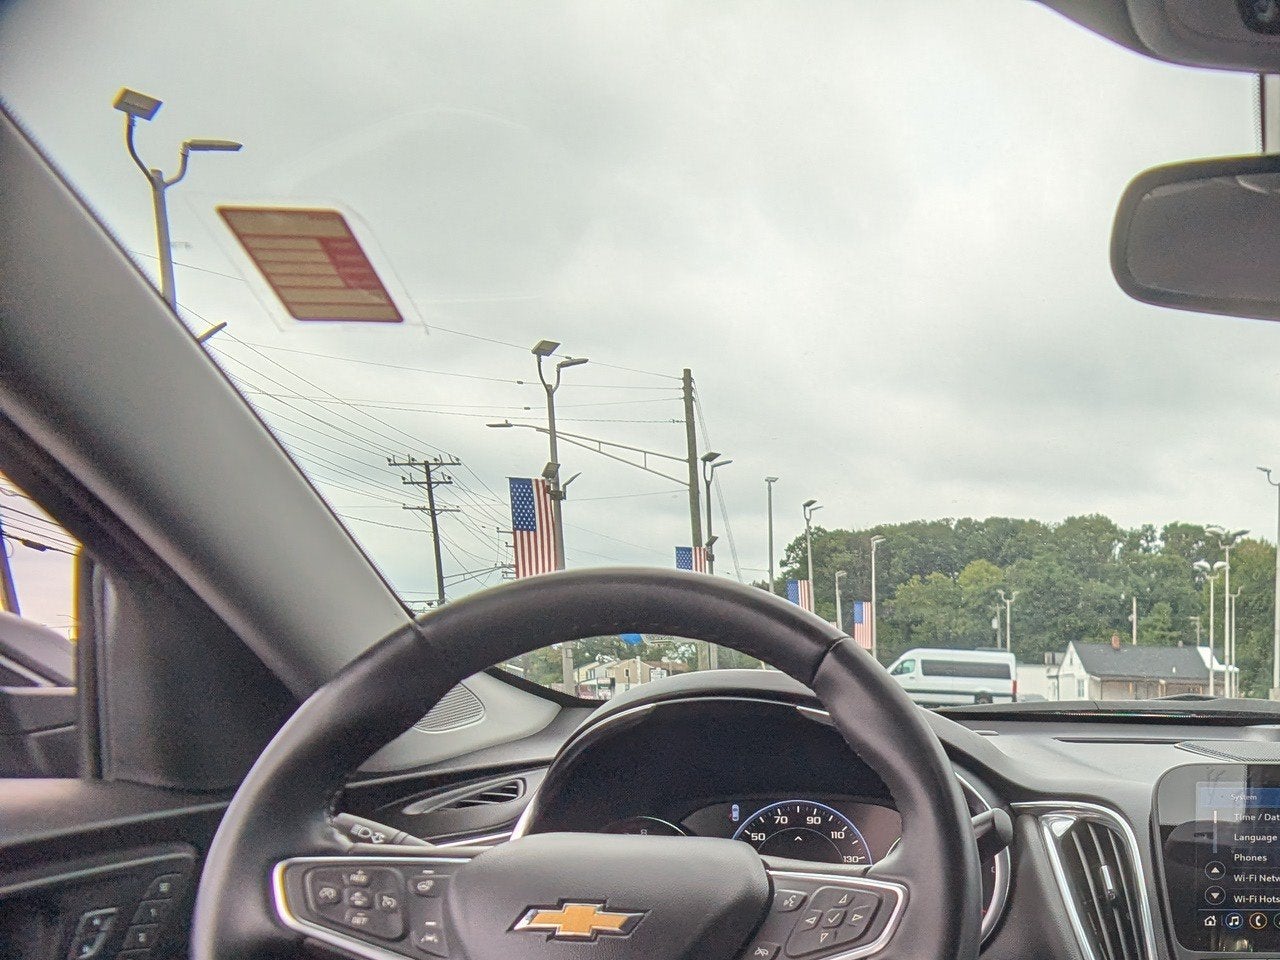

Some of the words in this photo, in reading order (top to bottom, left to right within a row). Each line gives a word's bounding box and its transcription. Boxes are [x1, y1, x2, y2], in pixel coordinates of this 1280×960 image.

[1231, 793, 1258, 802] System
[774, 815, 788, 824] 70
[806, 816, 822, 825] 90
[1234, 813, 1256, 821] Time
[751, 832, 766, 842] 50
[830, 831, 845, 839] 110
[1234, 833, 1278, 843] Language
[843, 855, 859, 863] 130
[1234, 853, 1268, 862] Phones
[1233, 874, 1258, 883] Wi-Fi
[1233, 895, 1258, 903] Wi-Fi
